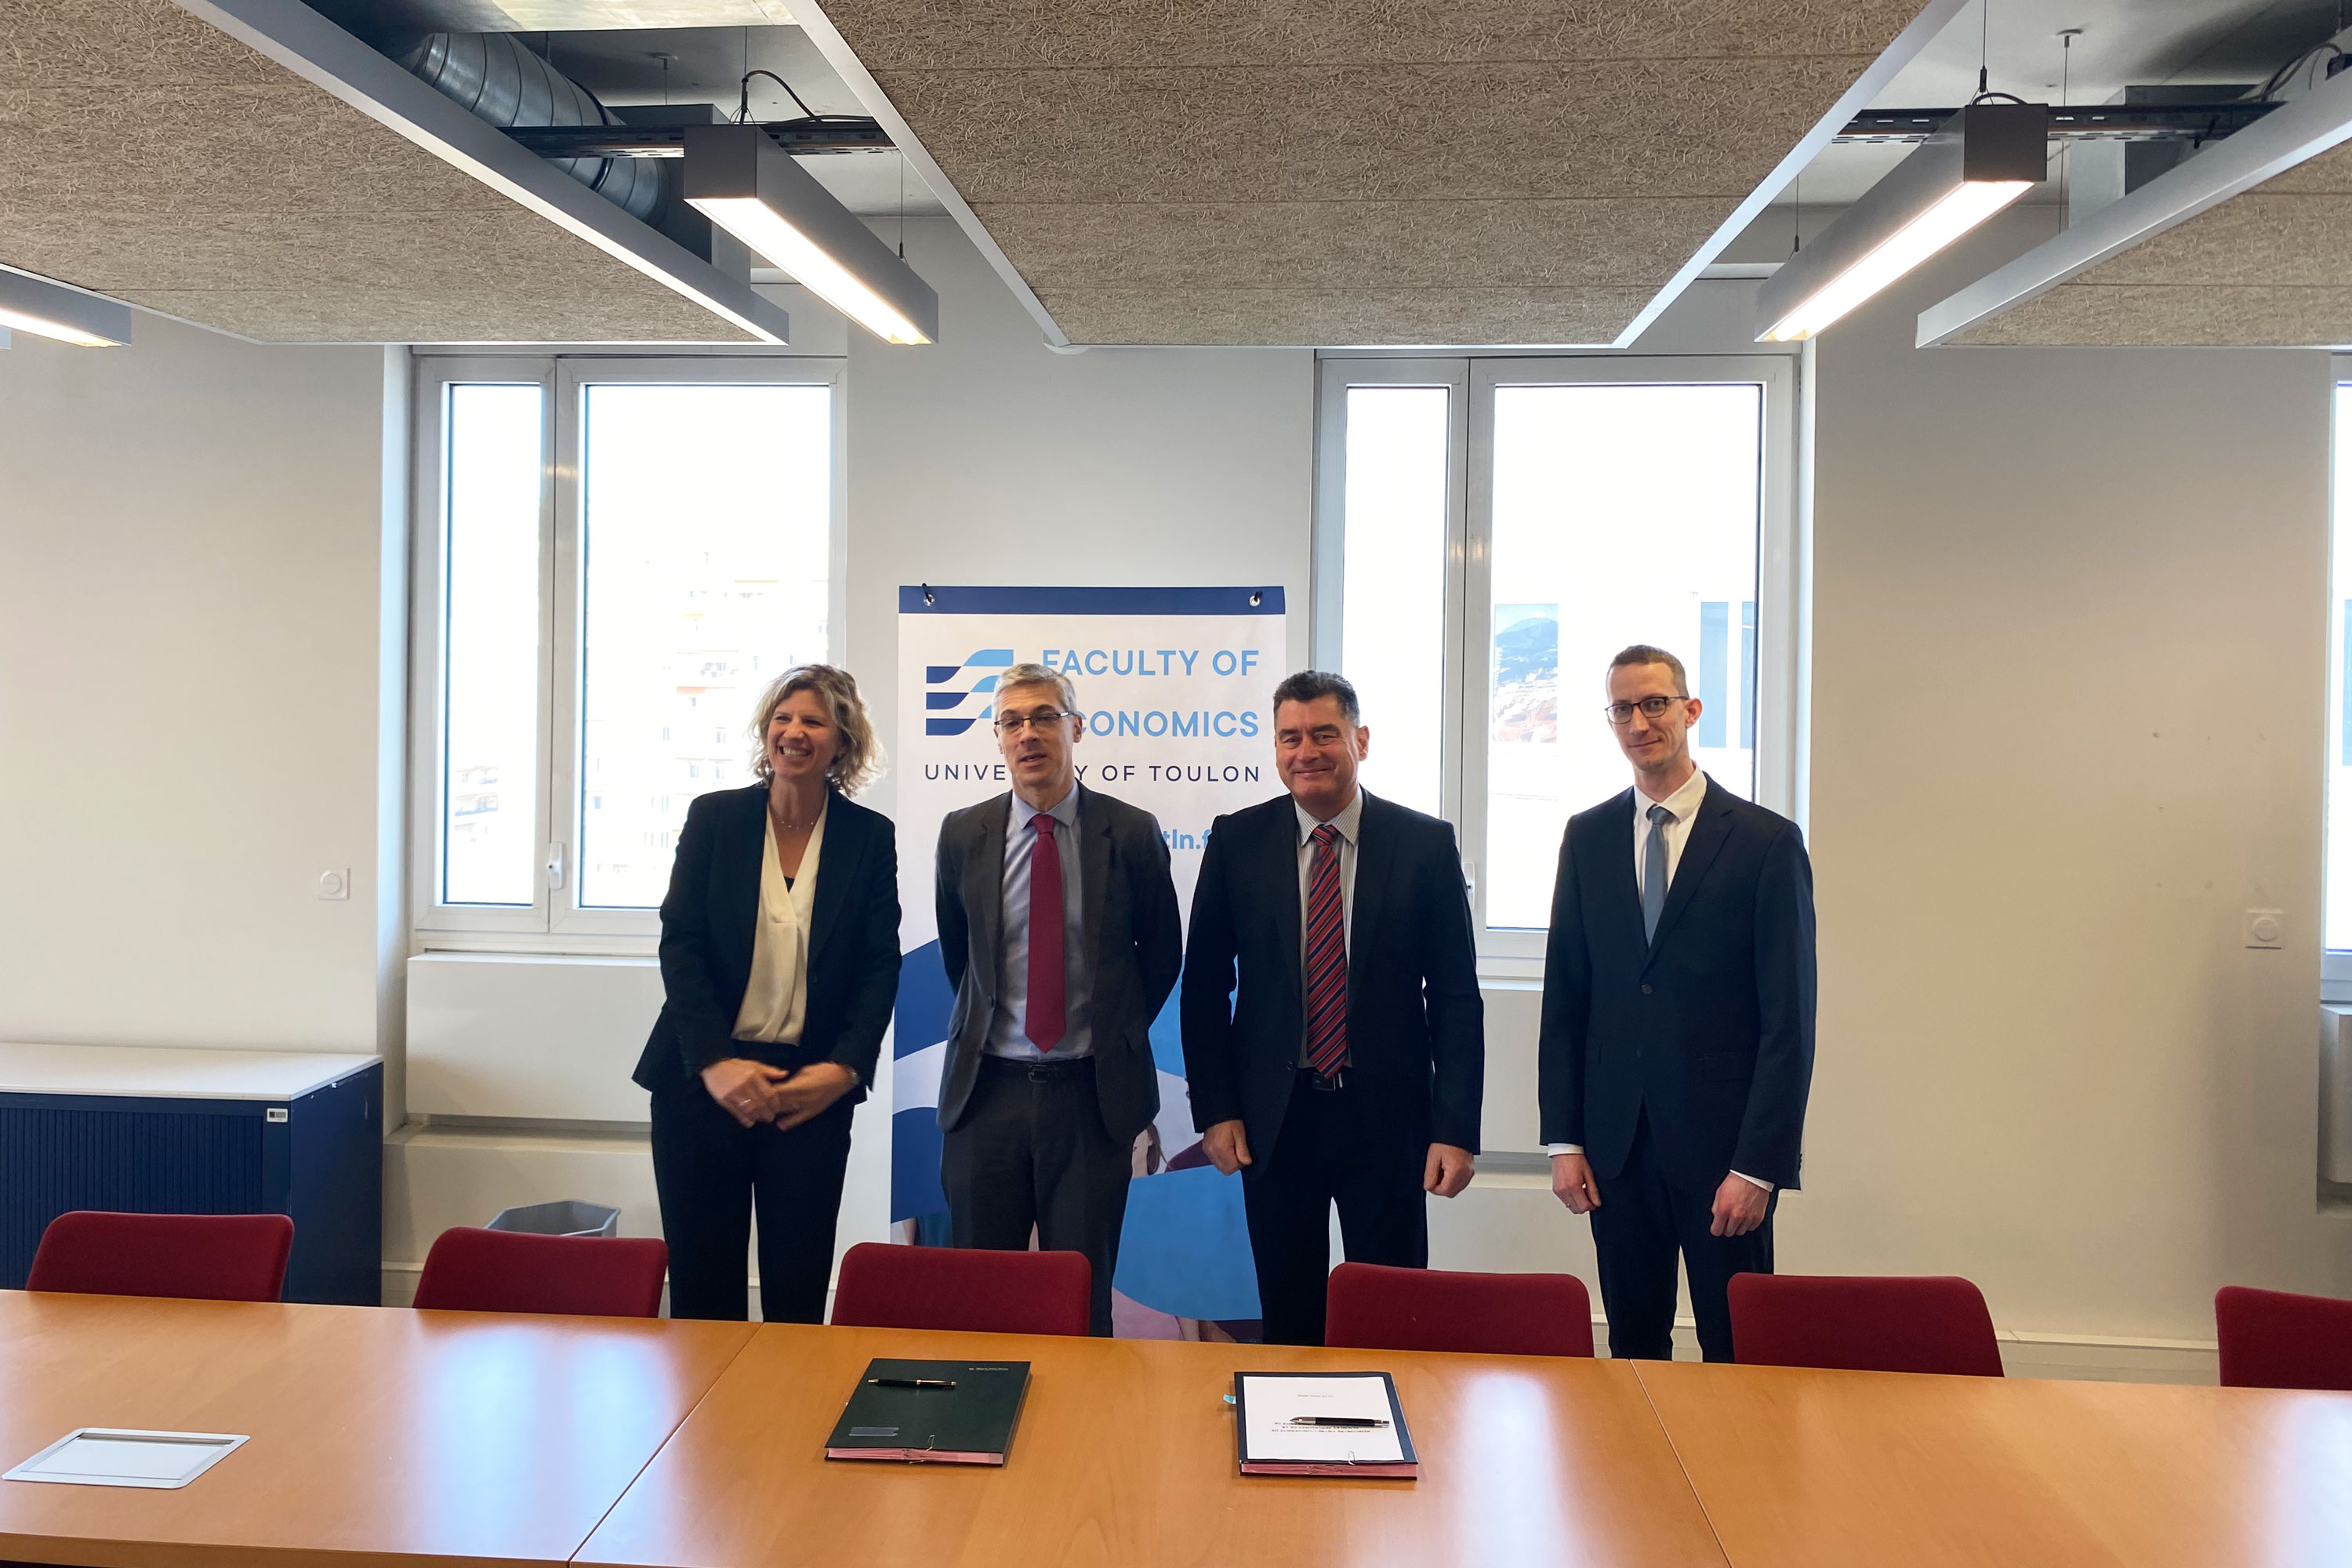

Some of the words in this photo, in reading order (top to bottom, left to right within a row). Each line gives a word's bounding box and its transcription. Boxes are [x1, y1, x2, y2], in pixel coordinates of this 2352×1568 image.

[1043, 649, 1200, 676] FACULTY
[1212, 650, 1259, 676] OF
[1076, 710, 1259, 737] ONOMICS
[925, 764, 1088, 781] UNIVEY
[1102, 764, 1135, 782] OF
[1149, 765, 1259, 782] TOULON
